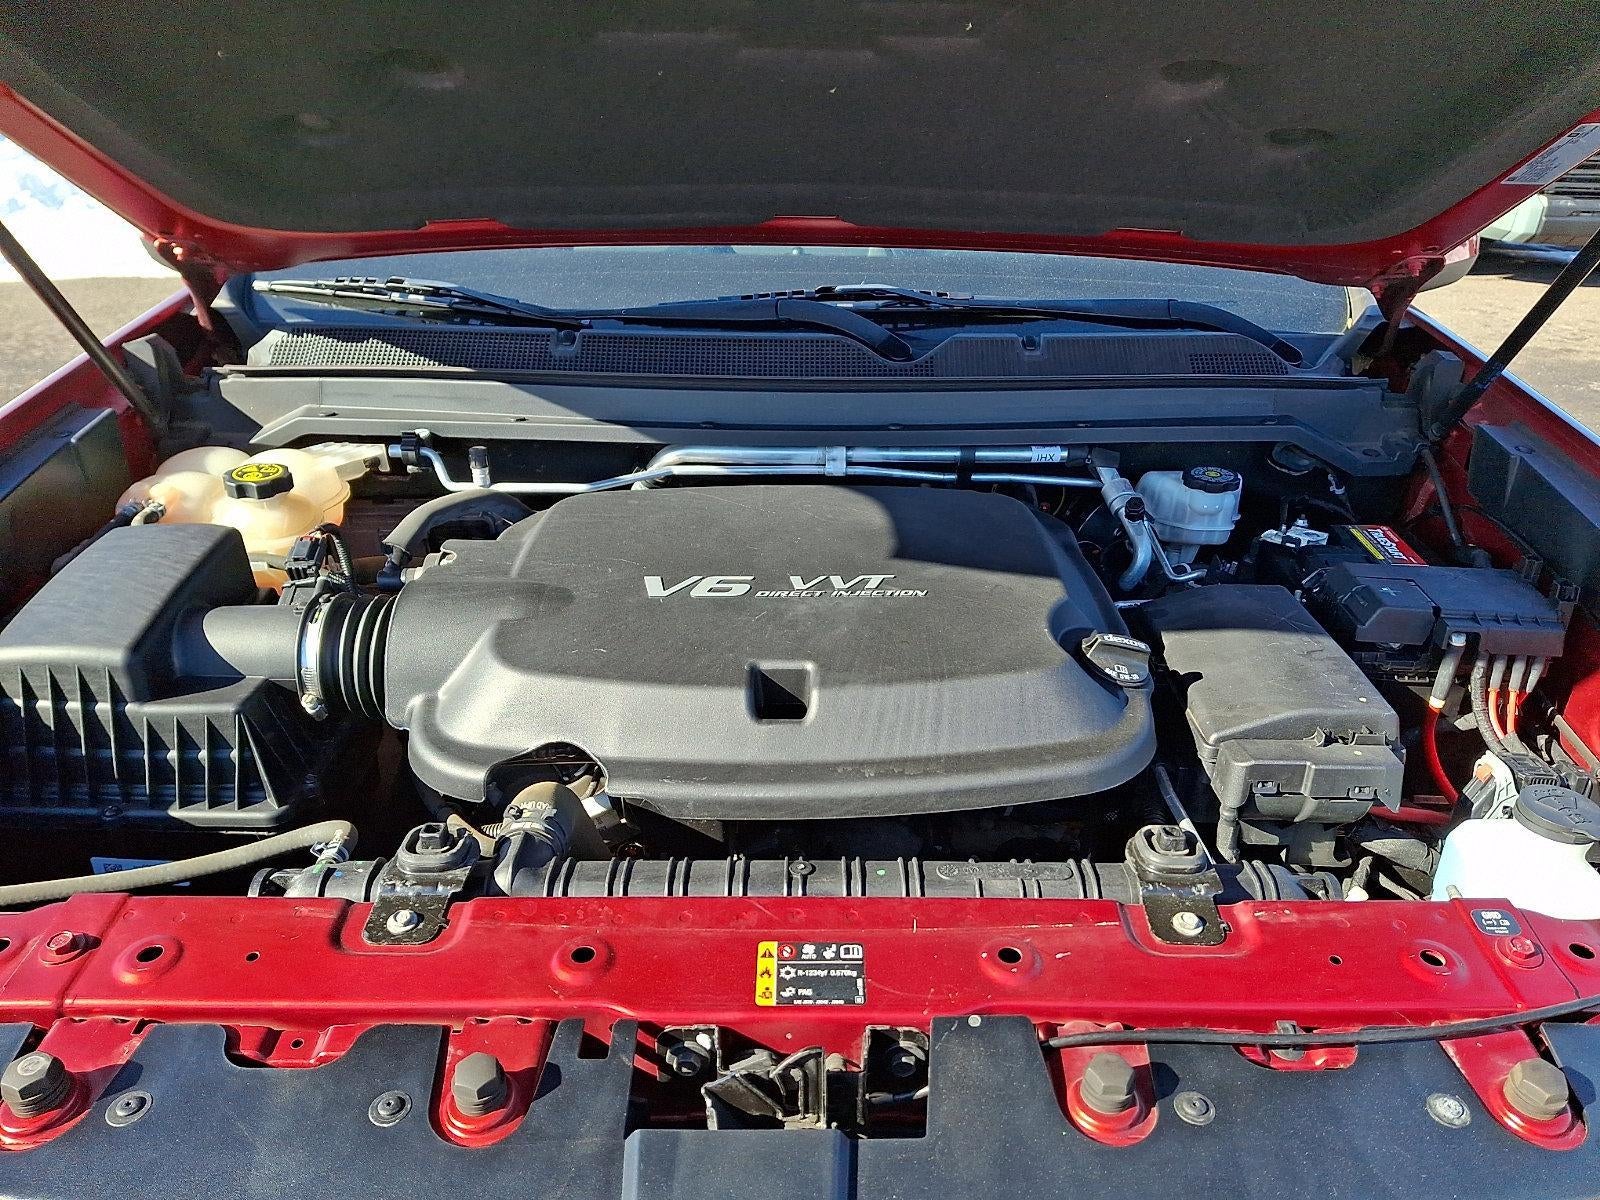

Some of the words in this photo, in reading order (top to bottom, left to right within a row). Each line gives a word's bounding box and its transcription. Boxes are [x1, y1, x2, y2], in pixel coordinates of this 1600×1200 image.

[643, 575, 755, 598] V6
[789, 574, 896, 591] VVT
[755, 589, 827, 598] DIRECT
[831, 589, 928, 598] INJECTION
